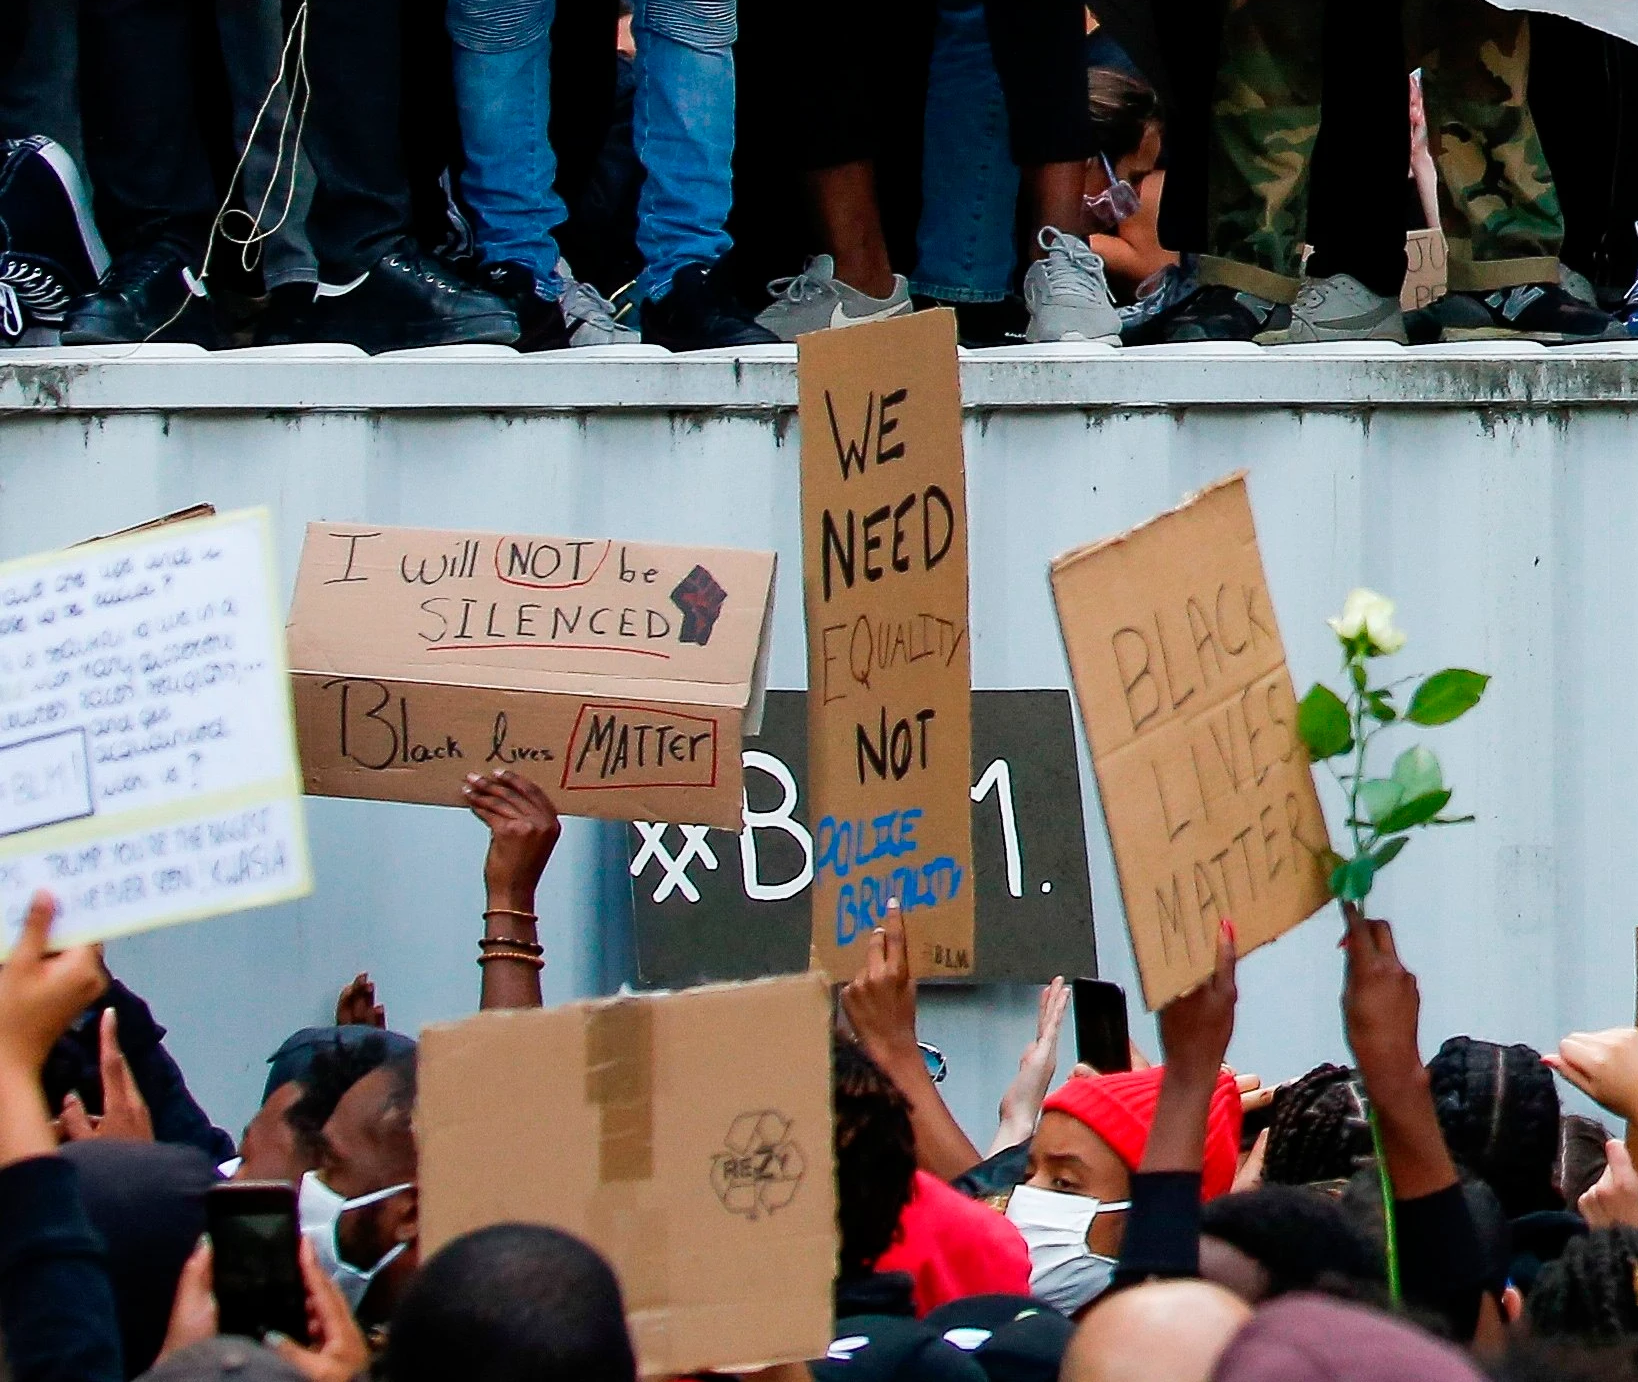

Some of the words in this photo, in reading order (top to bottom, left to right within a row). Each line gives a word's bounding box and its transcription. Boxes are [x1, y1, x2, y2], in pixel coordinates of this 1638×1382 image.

[824, 388, 909, 481] WE
[324, 533, 381, 585] I
[401, 541, 479, 585] will
[508, 541, 594, 579] NOT
[620, 553, 659, 584] be
[821, 485, 955, 602] NEED
[419, 597, 670, 643] SILENCED
[822, 616, 962, 706] EQUALITY
[1112, 584, 1272, 734] BLACK
[322, 679, 463, 770] Black
[856, 707, 935, 785] NOT
[1152, 683, 1296, 843] LIVES
[1154, 792, 1320, 968] MATTER
